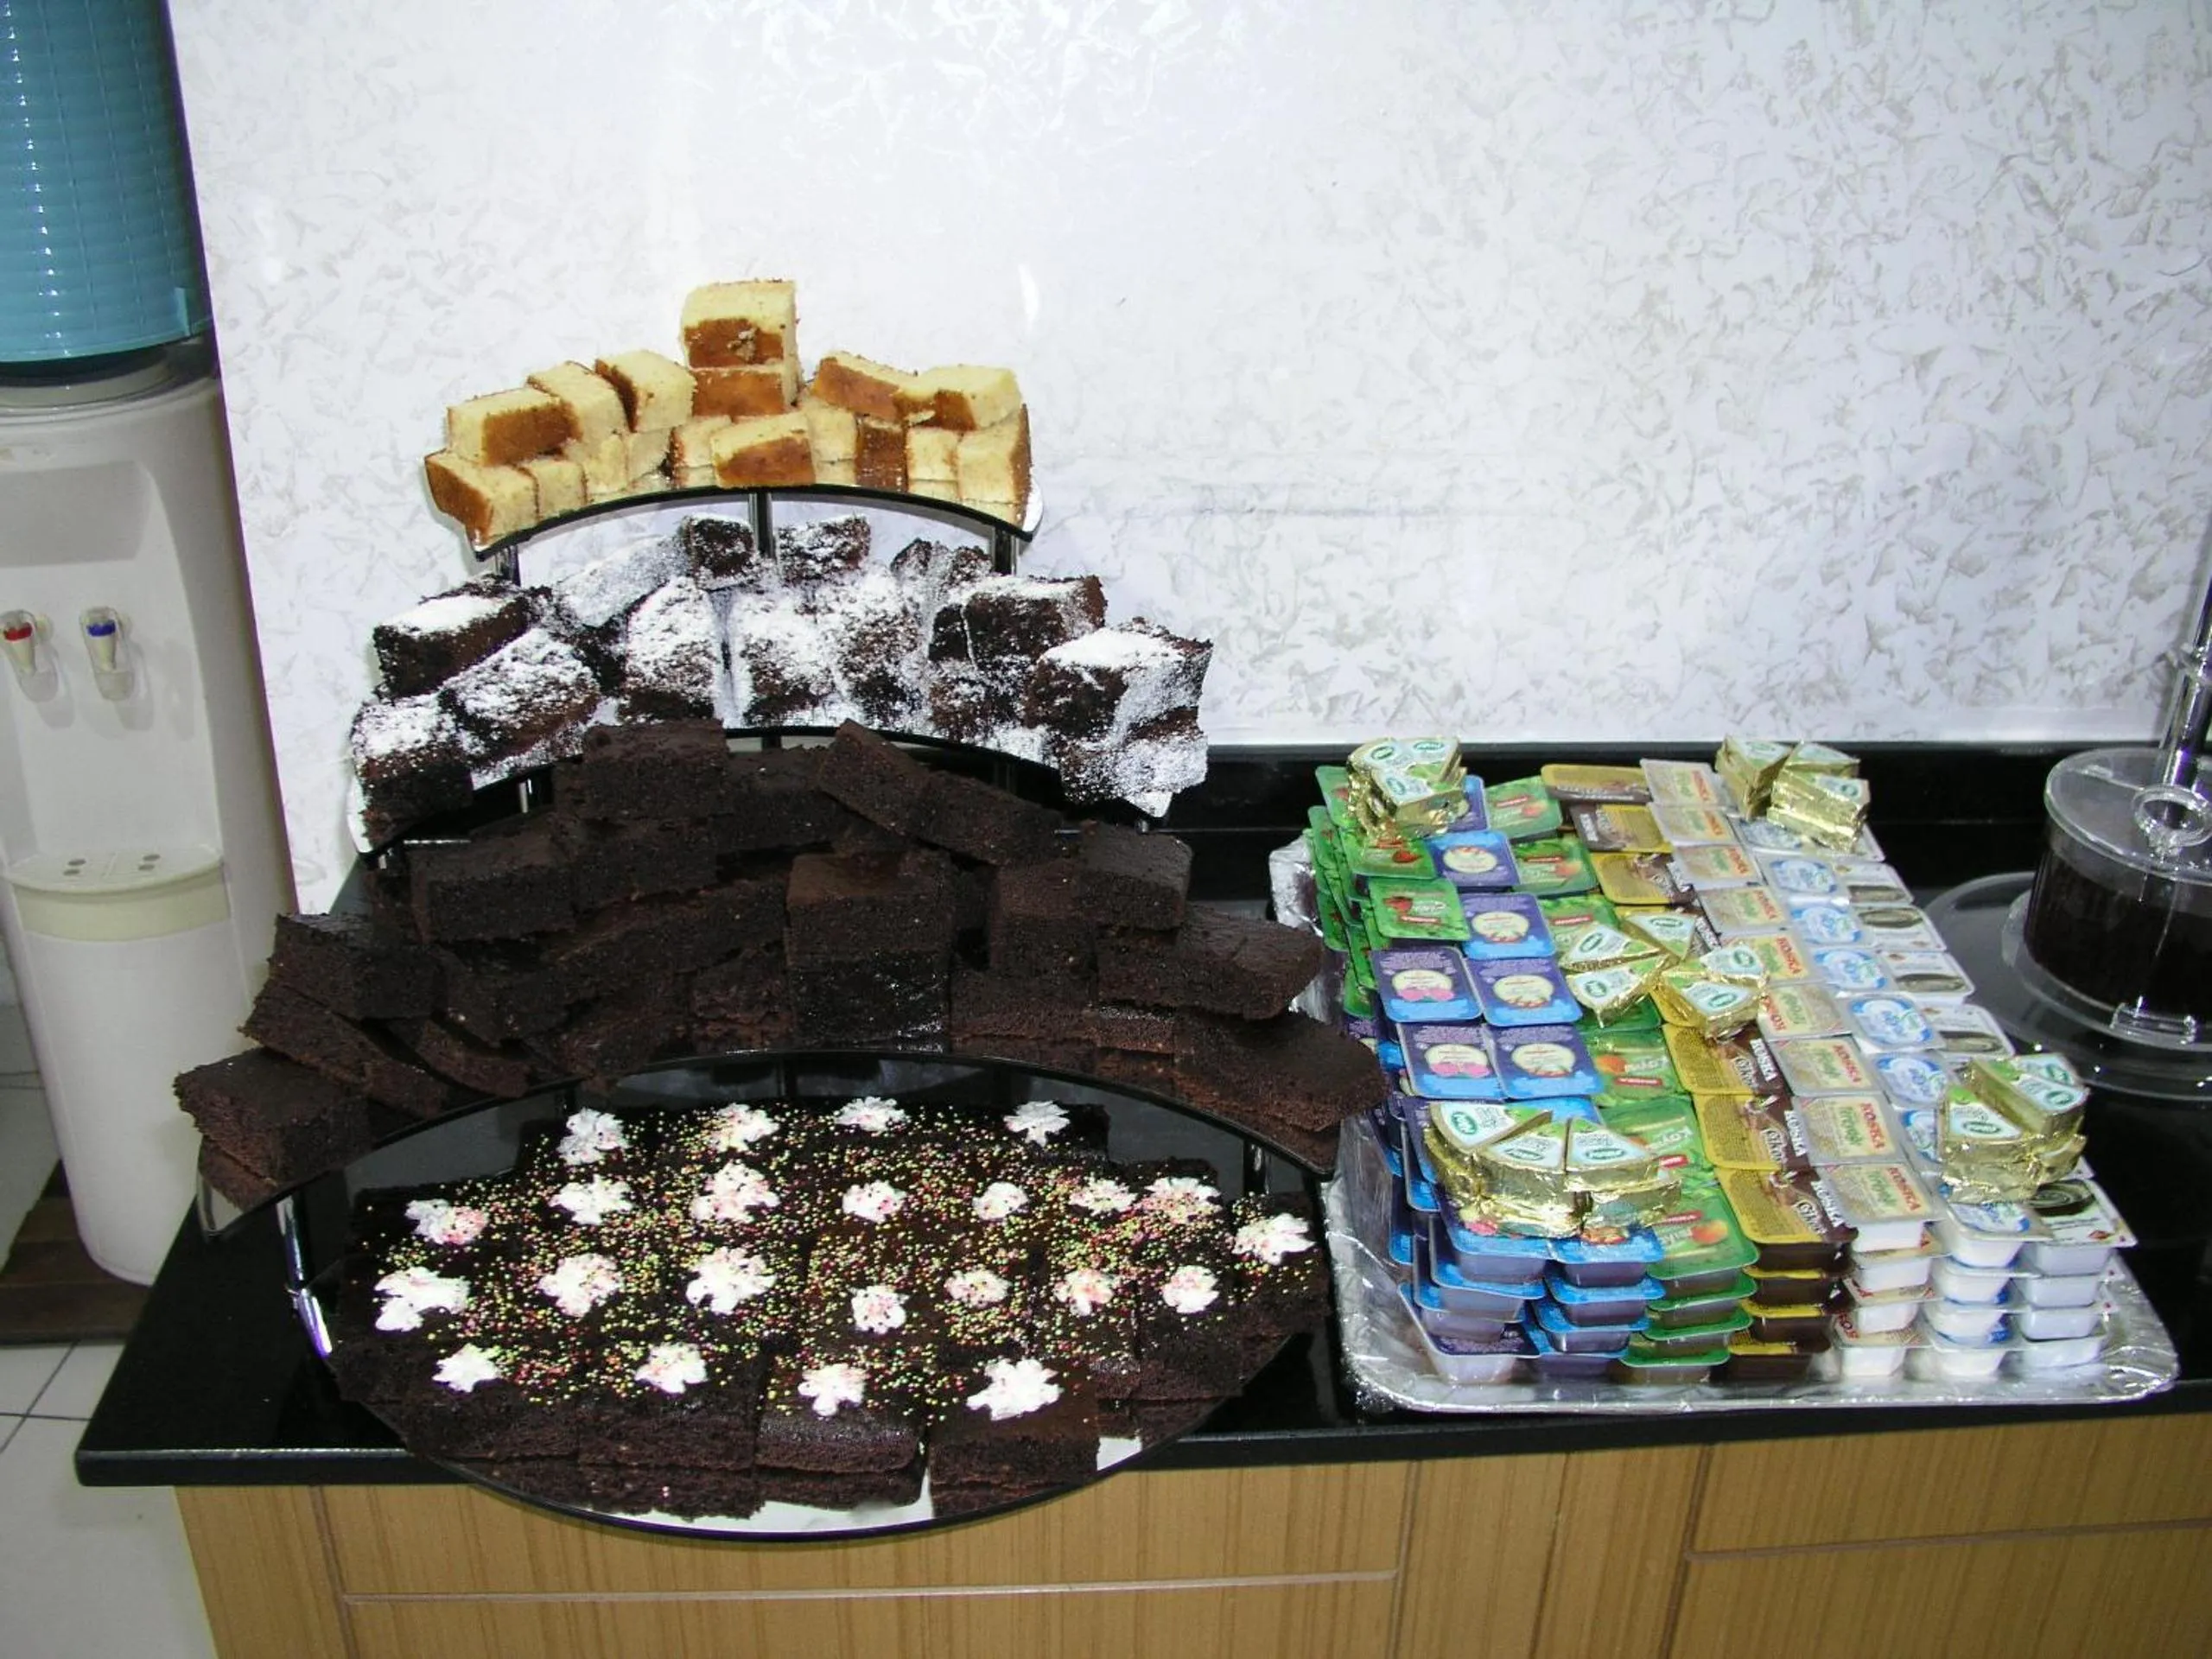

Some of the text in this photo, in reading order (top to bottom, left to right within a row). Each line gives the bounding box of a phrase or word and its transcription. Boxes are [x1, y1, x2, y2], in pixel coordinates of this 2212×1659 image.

[1776, 937, 1802, 975] KOSKA
[1749, 1038, 1778, 1082] KOSKA
[1833, 1044, 1863, 1084] KOSKA
[1783, 1109, 1808, 1157] KOSKA
[1860, 1102, 1886, 1150] KOSKA
[1811, 1179, 1846, 1228] KOSKA
[1889, 1166, 1922, 1211] KOSKA
[1837, 1312, 1859, 1339] KOS
